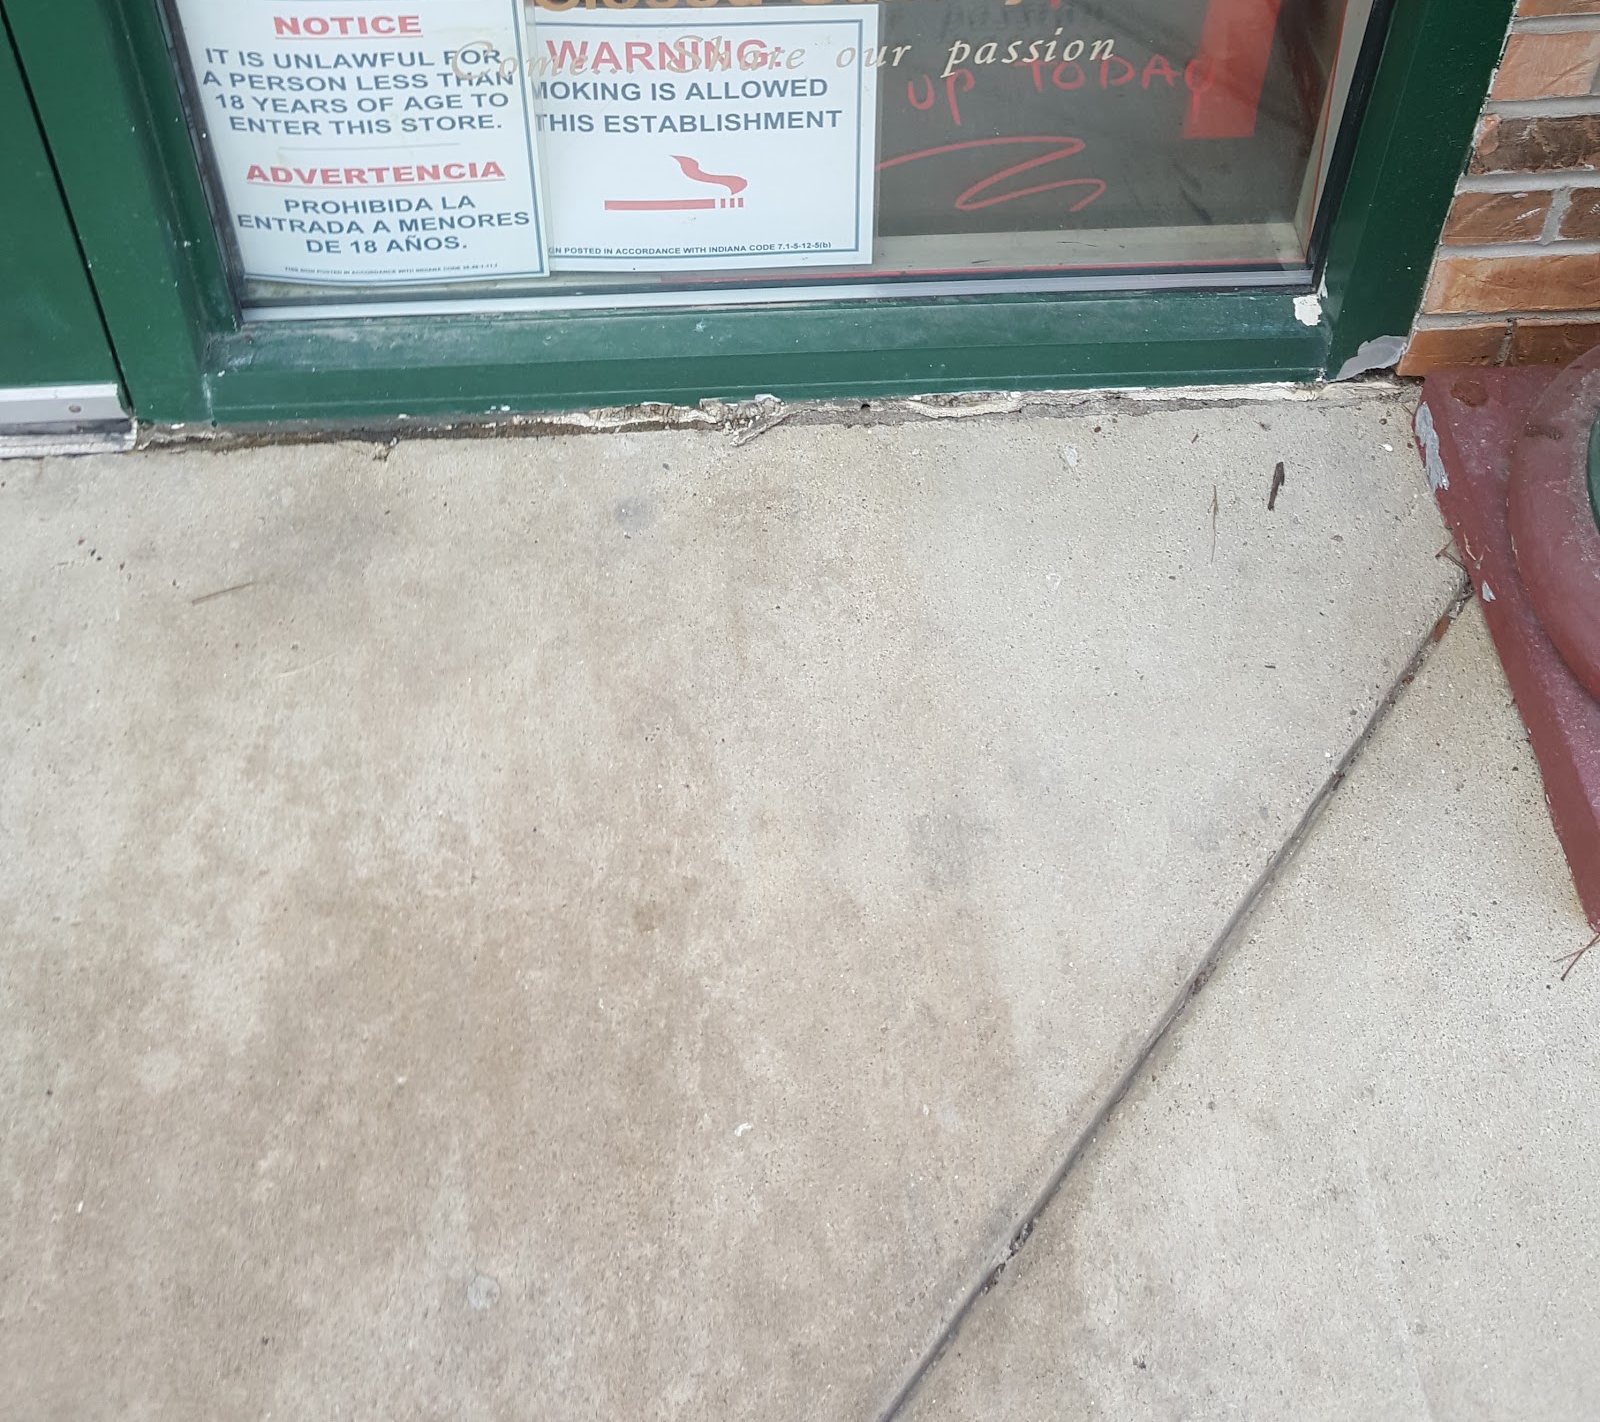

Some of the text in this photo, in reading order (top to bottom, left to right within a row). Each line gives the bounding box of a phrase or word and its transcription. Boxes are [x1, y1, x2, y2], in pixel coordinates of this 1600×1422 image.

[273, 15, 422, 36] NOTICE
[205, 48, 502, 70] IT IS UNLAWFUL FOR
[546, 39, 783, 71] WARNING:
[836, 42, 912, 68] our
[940, 27, 1117, 79] passion
[203, 70, 514, 92] A PERSON LESS THAN
[533, 78, 828, 102] MOKING IS ALLOWED
[215, 92, 509, 114] 18 YEARS OF AGE TO
[229, 114, 503, 136] ENTER THIS STORE.
[604, 110, 843, 133] ESTABLISHMENT
[246, 161, 506, 186] ADVERTENCIA
[284, 194, 475, 215] PROHIBIDA LA
[237, 211, 530, 235] ENTRADA A MENORES
[306, 234, 468, 254] DE 18 AÑOS.
[564, 247, 601, 255] POSTED
[604, 247, 613, 255] IN
[615, 247, 680, 255] ACCORDANCE
[683, 246, 707, 254] WITH
[709, 244, 747, 253] INDIANA
[749, 243, 775, 252] CODE
